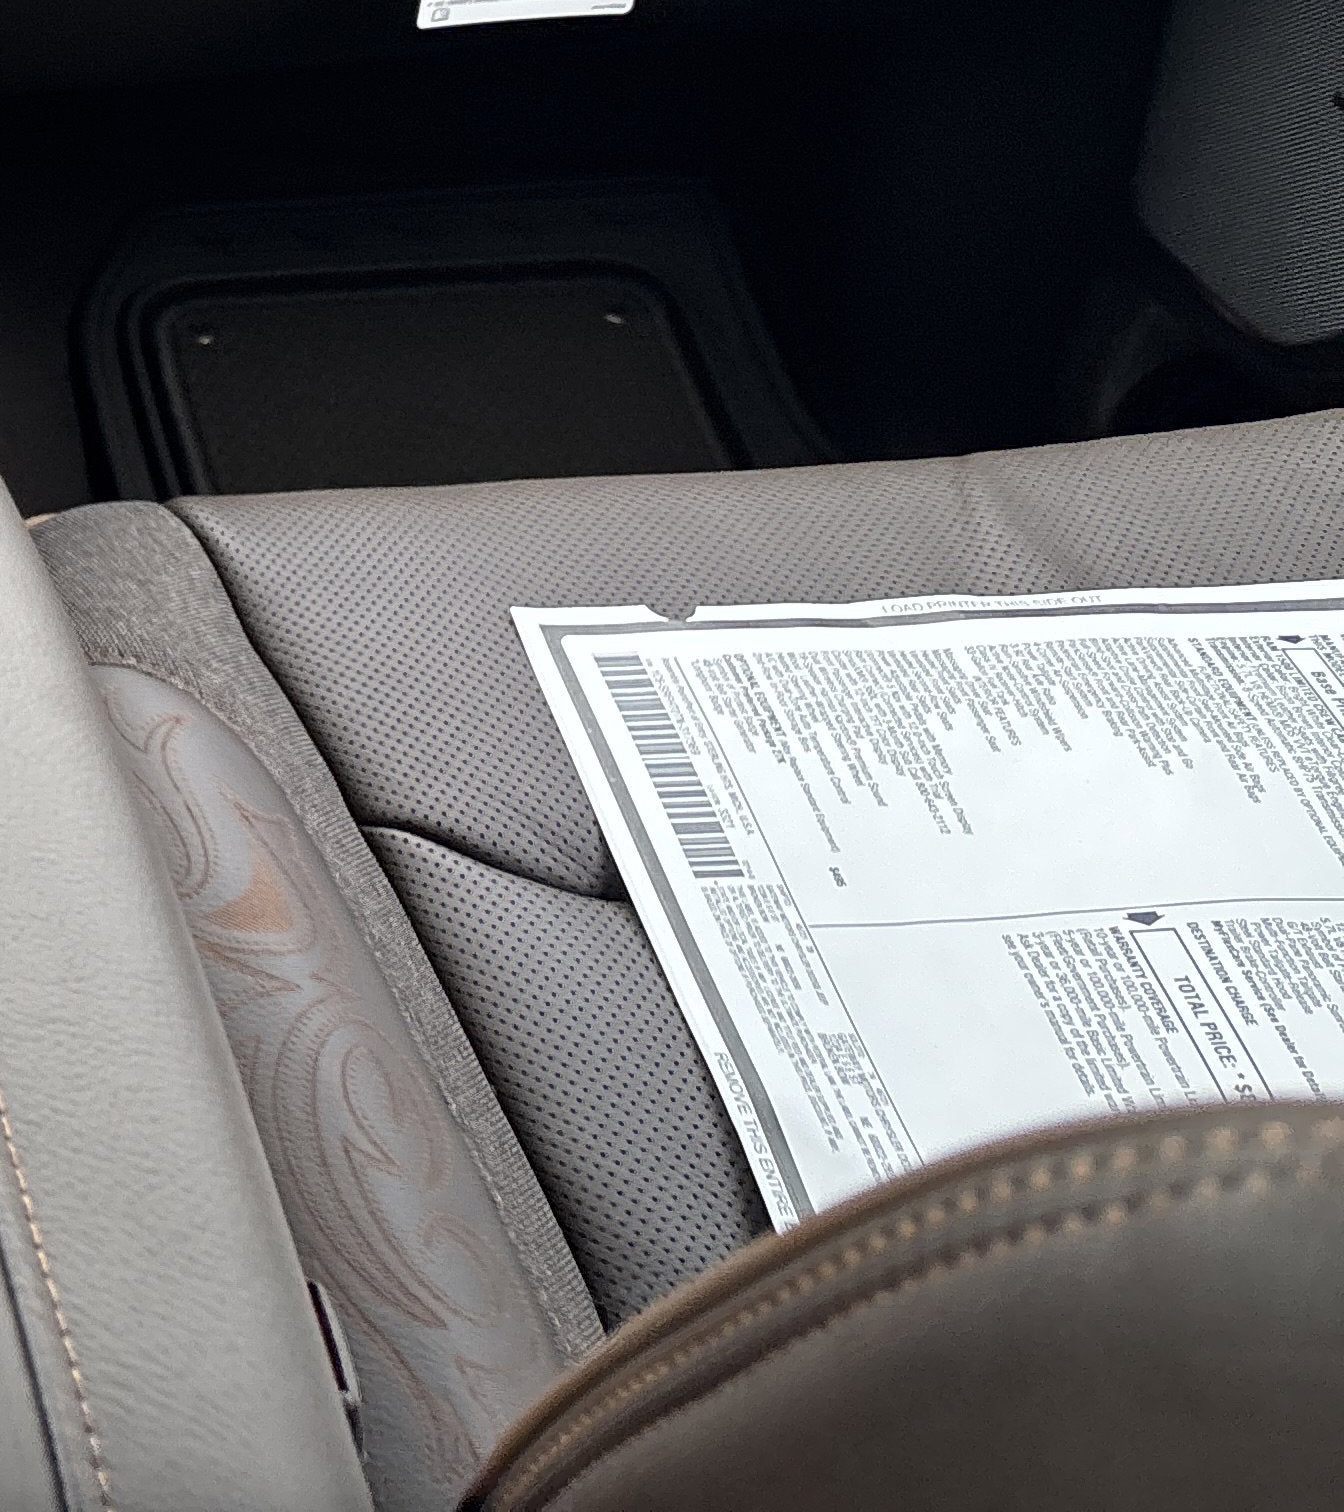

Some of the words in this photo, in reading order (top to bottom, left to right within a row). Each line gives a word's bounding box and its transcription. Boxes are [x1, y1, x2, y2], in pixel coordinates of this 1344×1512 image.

[1106, 926, 1149, 979] WARRANTY
[1137, 981, 1181, 1034] COVERAGE
[1170, 975, 1214, 1019] TOTAL
[1197, 1022, 1242, 1068] PRICE:
[1184, 922, 1235, 983] DESTINATION
[1222, 985, 1260, 1026] CHARGE
[1152, 1037, 1195, 1088] Powertrain
[713, 1050, 754, 1117] REMOVE
[742, 1116, 768, 1156] THIS
[757, 1156, 796, 1219] ENTIRE
